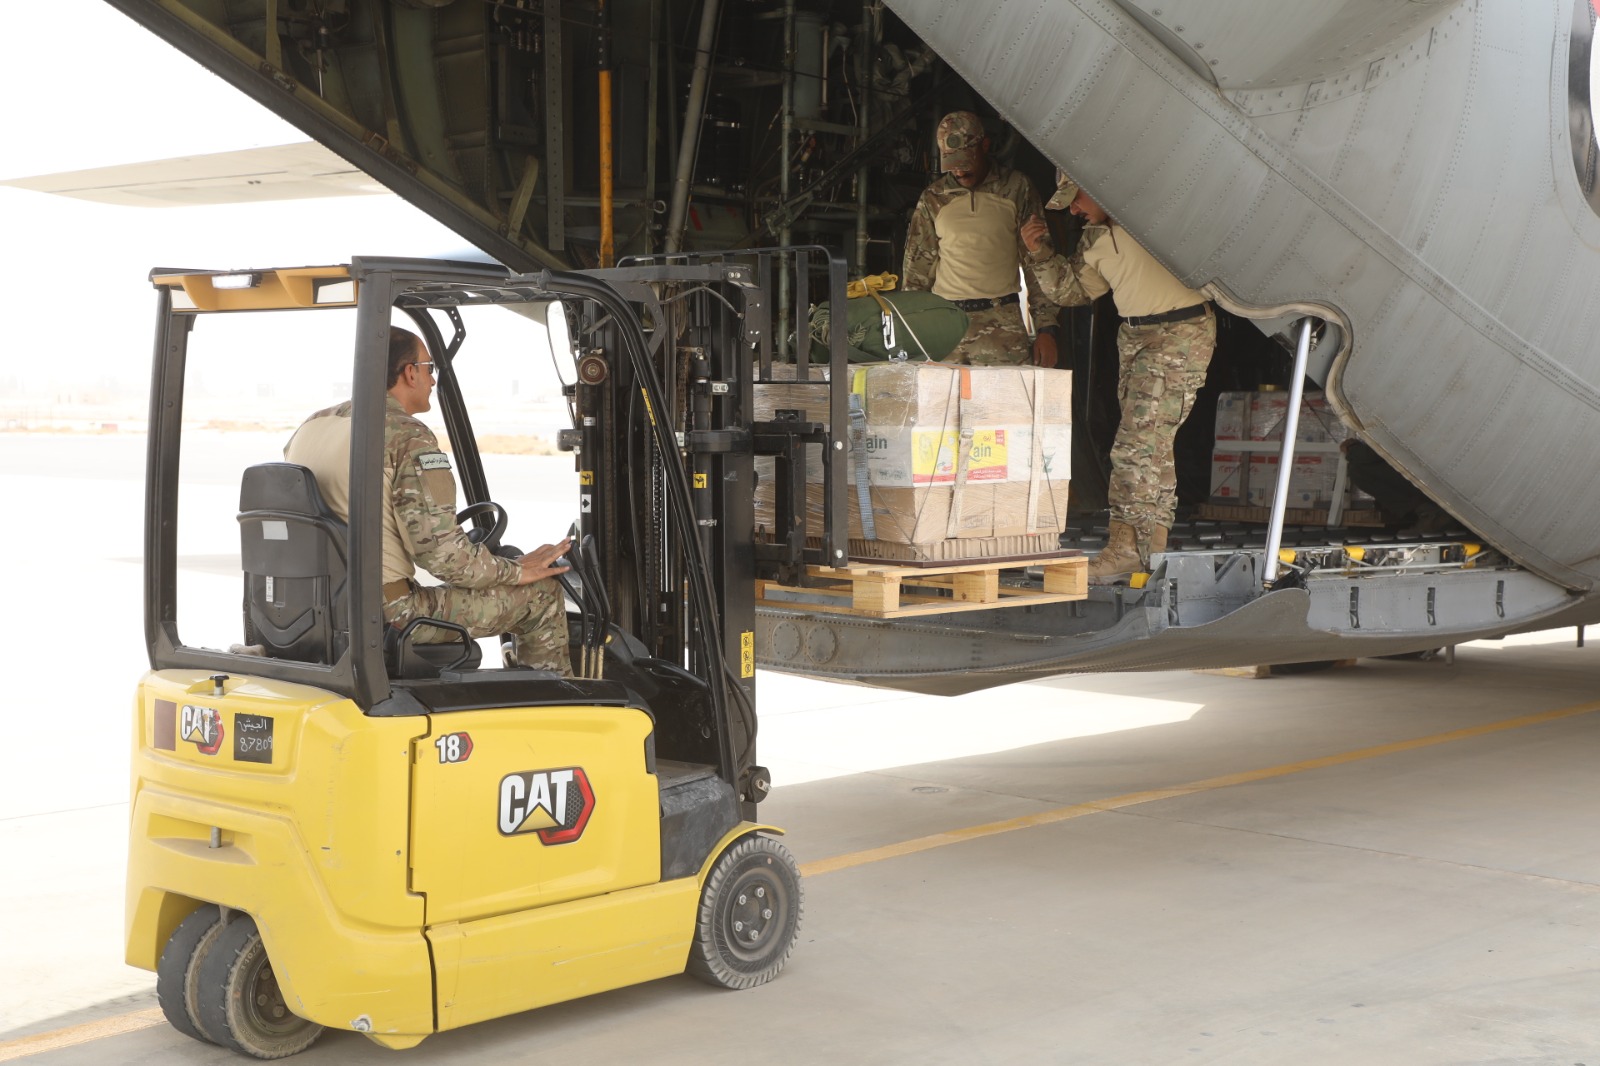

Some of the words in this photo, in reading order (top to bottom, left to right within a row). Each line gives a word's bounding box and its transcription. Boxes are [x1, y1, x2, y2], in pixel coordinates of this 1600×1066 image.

[970, 443, 992, 462] ain
[181, 705, 214, 743] CAT
[236, 717, 267, 733] الجيش
[436, 734, 461, 762] 18
[500, 769, 574, 834] CAT
